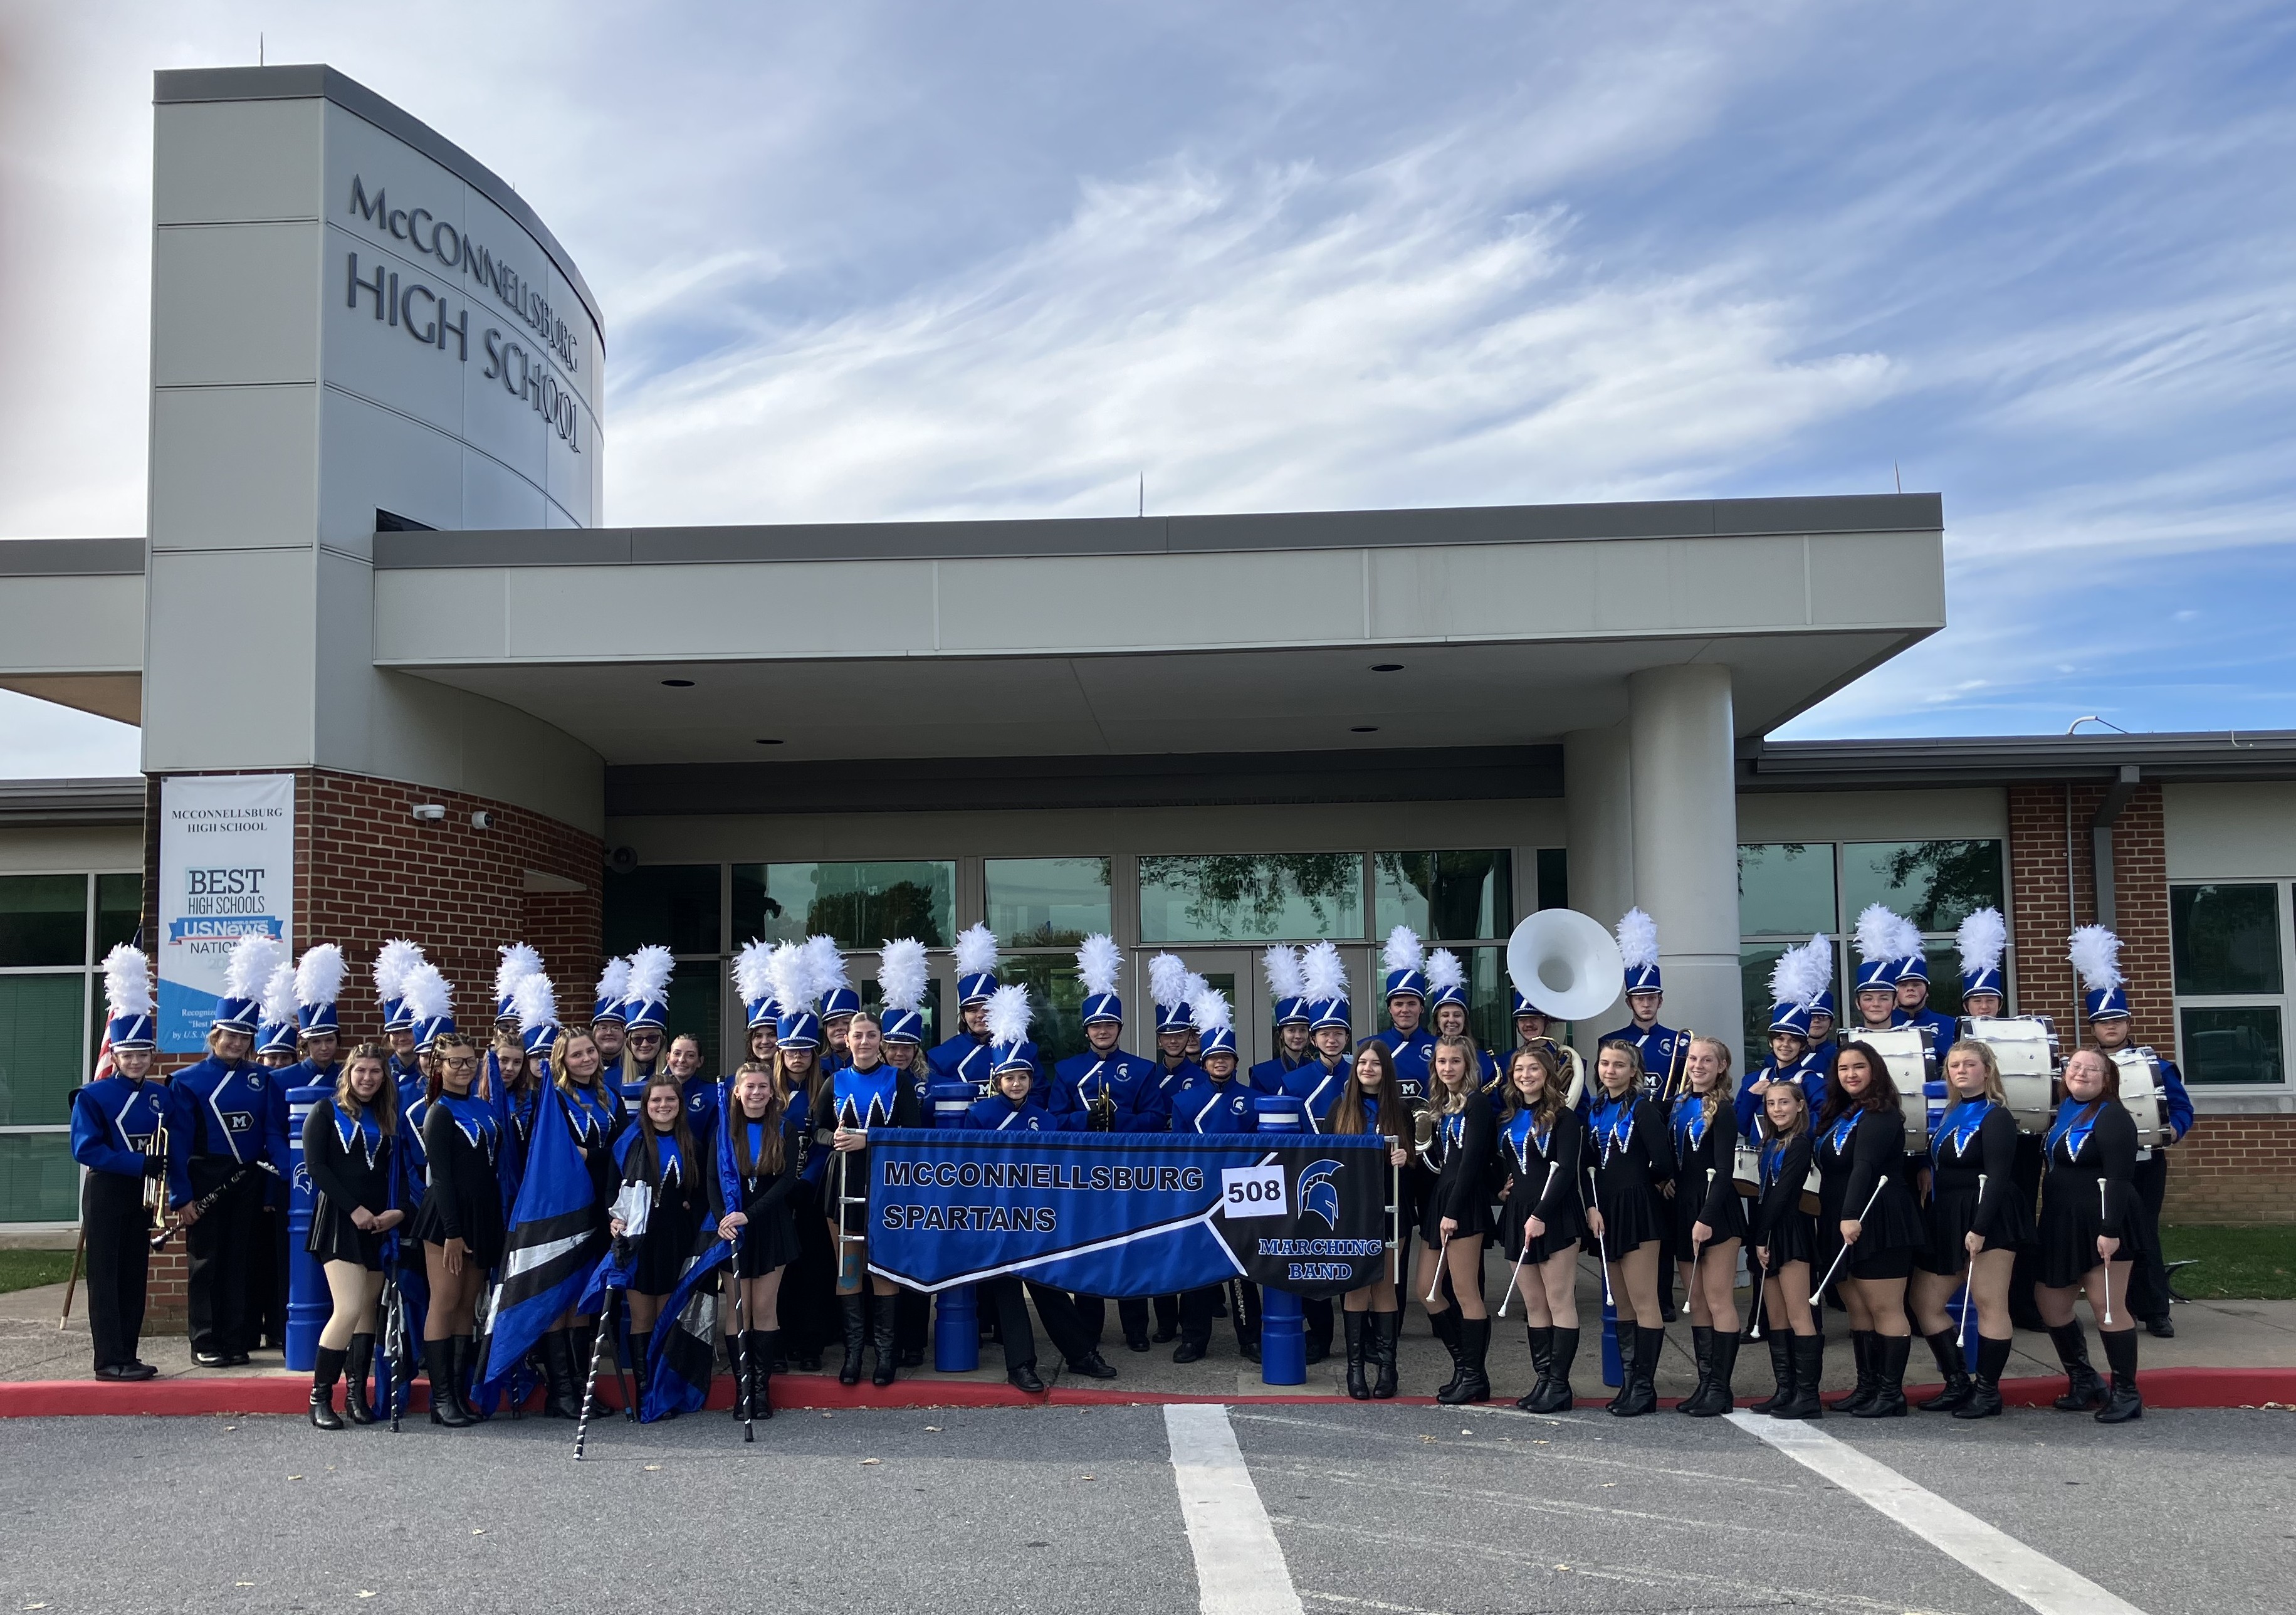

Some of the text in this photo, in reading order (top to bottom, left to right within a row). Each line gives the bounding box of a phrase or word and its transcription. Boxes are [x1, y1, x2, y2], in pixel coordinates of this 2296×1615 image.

[348, 251, 581, 454] HIGH SCHOOL
[172, 808, 283, 819] MCCONNELLSBURG
[187, 822, 268, 833] HIGH SCHOOL
[189, 868, 265, 895] BEST
[189, 895, 265, 915] HIGH SCHOOLS
[978, 1084, 990, 1095] M
[1402, 1083, 1415, 1095] M
[1644, 1075, 1657, 1086] M
[232, 1115, 247, 1128] M
[883, 1160, 1205, 1192] MCCONNELLSBURG
[1228, 1179, 1281, 1204] 508
[883, 1204, 1057, 1233] SPARTANS
[1258, 1238, 1382, 1256] MARCHING
[1287, 1262, 1353, 1281] BAND
